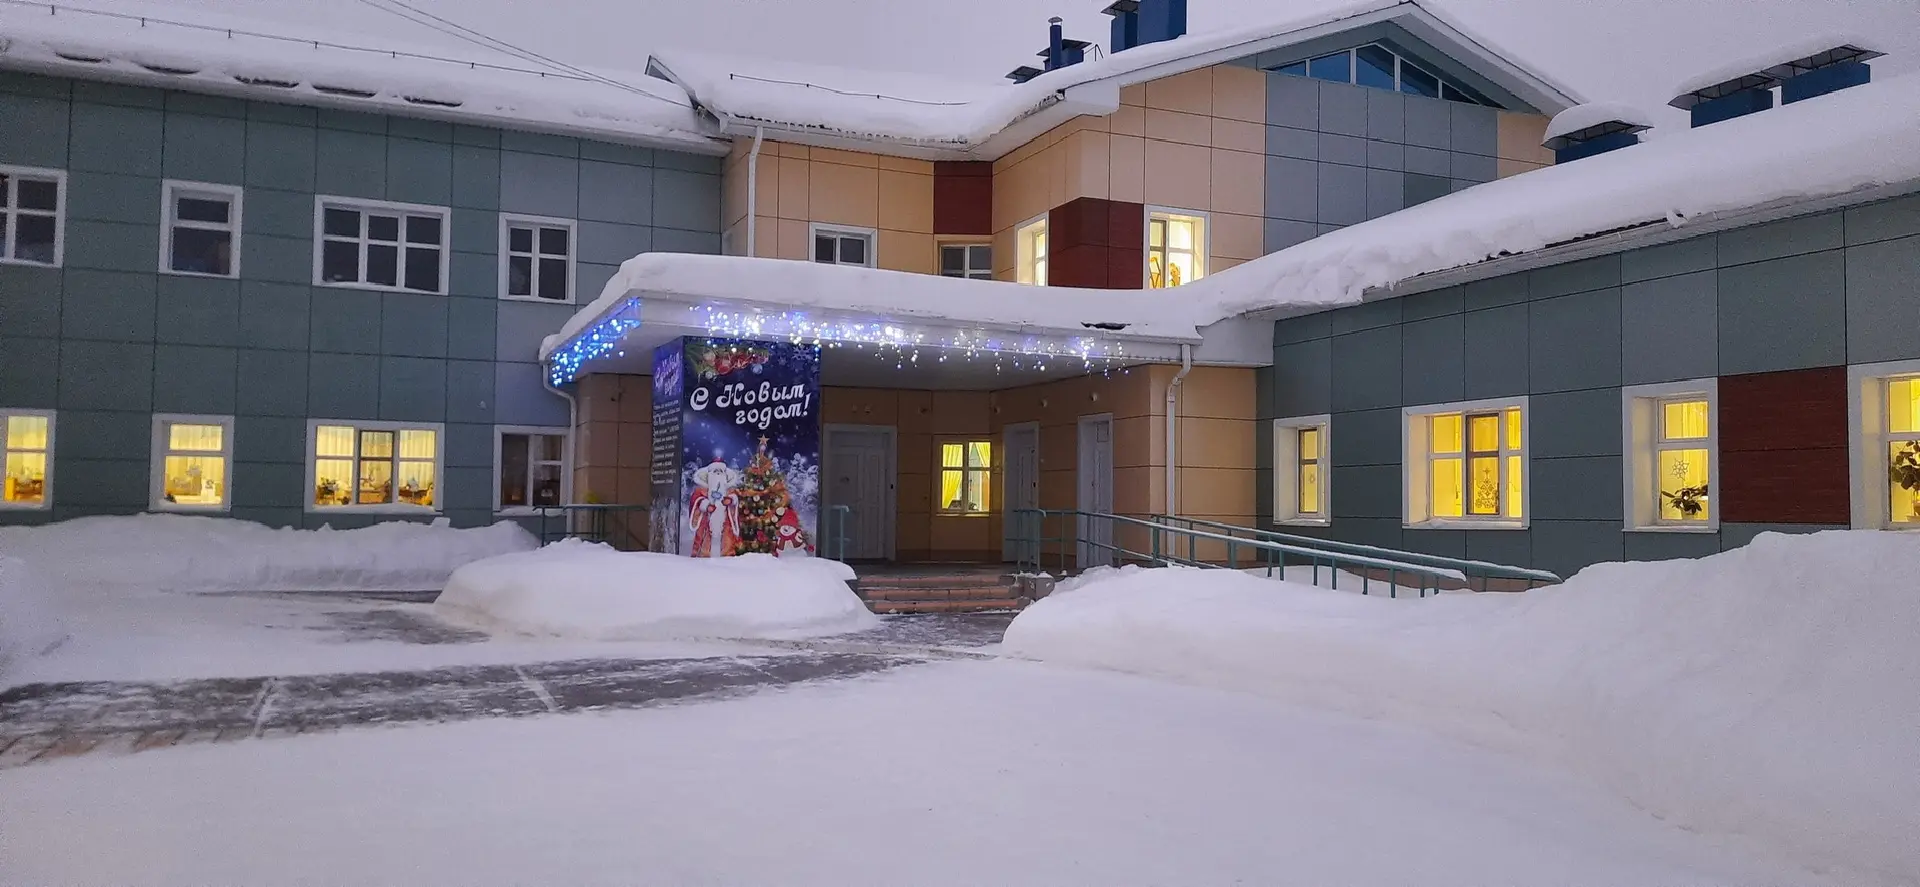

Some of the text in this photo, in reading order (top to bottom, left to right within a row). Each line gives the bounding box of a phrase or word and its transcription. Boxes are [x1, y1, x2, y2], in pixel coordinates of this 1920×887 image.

[690, 381, 804, 411] С Новым
[735, 392, 811, 430] годом!
